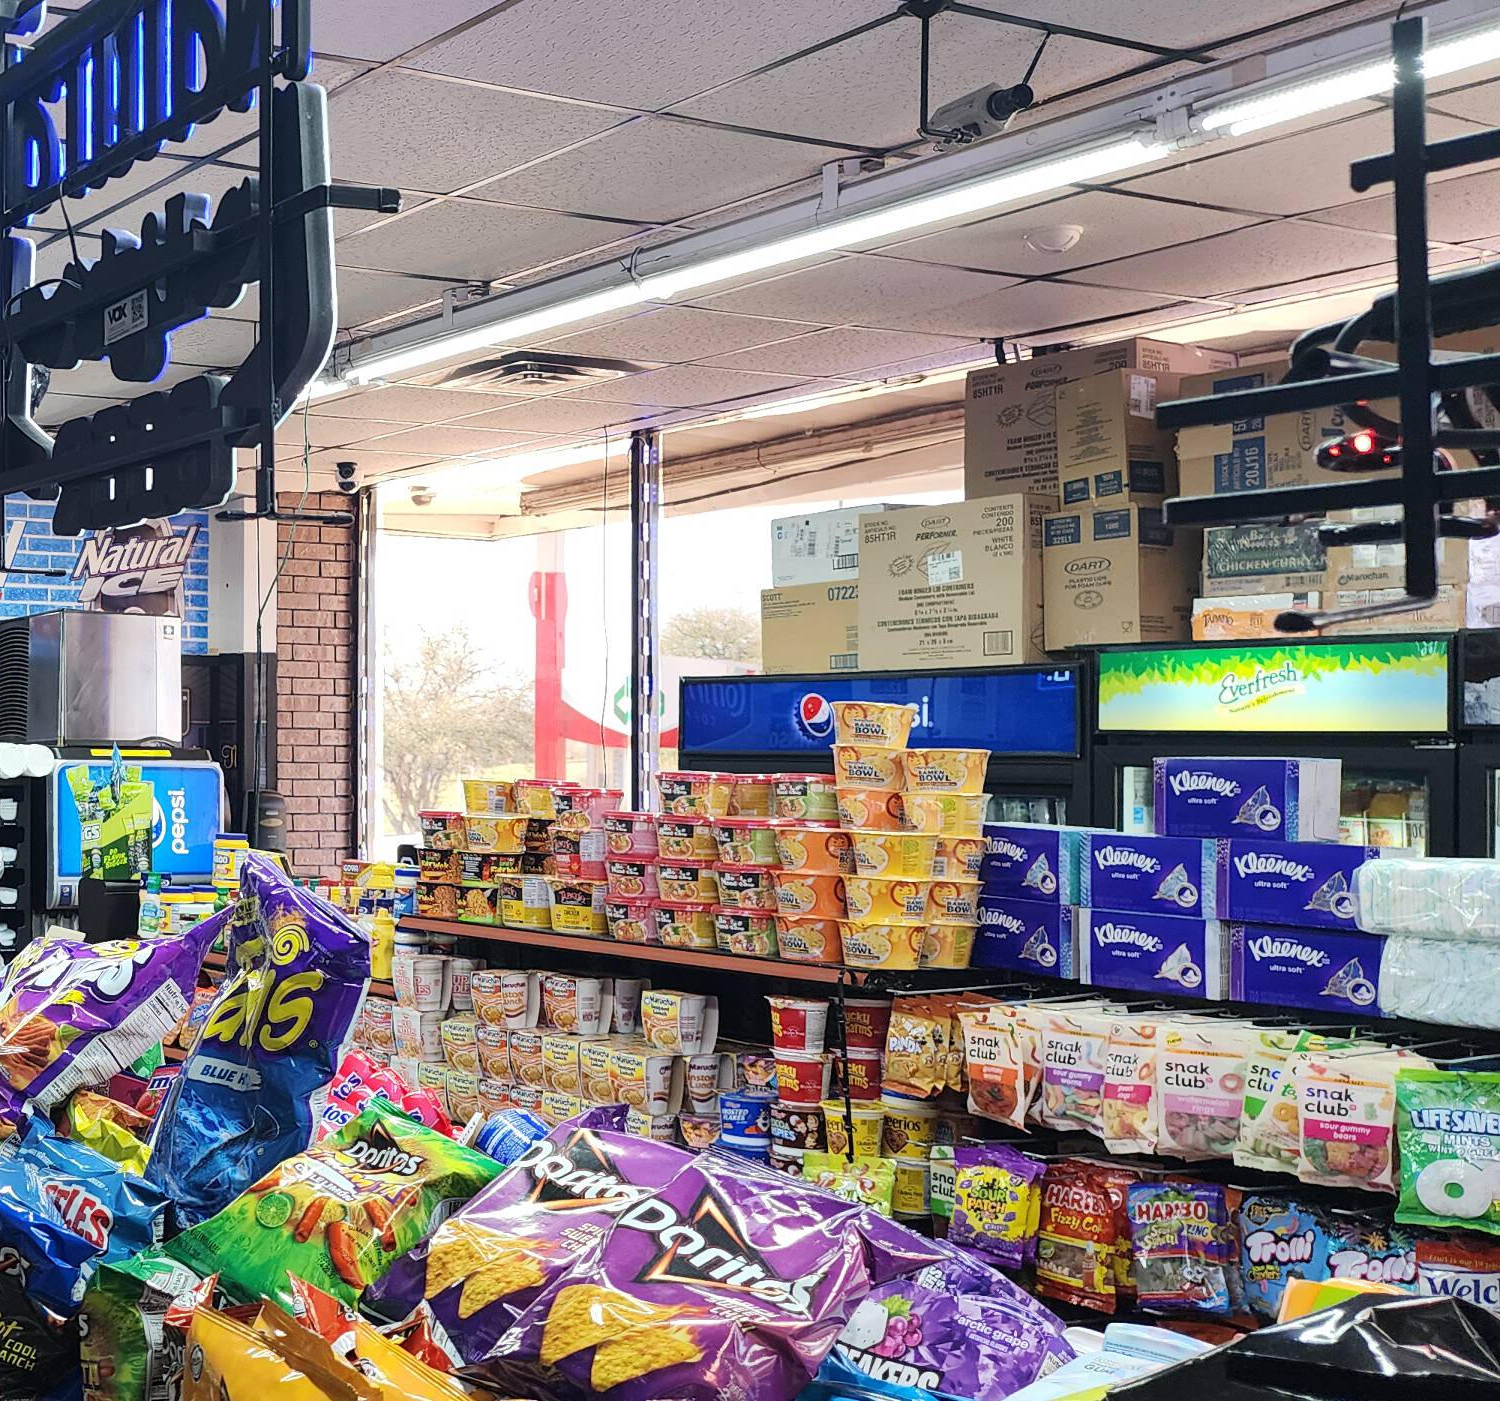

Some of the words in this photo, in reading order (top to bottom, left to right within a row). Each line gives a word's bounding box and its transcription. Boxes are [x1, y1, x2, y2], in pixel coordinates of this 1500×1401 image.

[107, 302, 127, 325] VOX
[973, 384, 1004, 400] 85HT1R
[1245, 447, 1260, 487] 20J16
[996, 517, 1014, 528] 200
[864, 531, 896, 544] 85HT1R
[72, 523, 200, 582] Natural
[1070, 560, 1105, 572] DART
[1219, 559, 1271, 573] CHICKEN
[78, 567, 184, 603] ICE
[1218, 662, 1297, 705] Everfresh
[855, 727, 886, 736] BOWL
[848, 769, 880, 778] BOWL
[919, 774, 951, 782] BOWL
[1168, 769, 1236, 796] Kleenex
[168, 787, 189, 855] pepsi
[1093, 844, 1157, 872] Kleenex
[1233, 850, 1311, 882] Kleenex
[1111, 872, 1125, 880] ultra
[1254, 880, 1272, 888] ultra
[1274, 881, 1289, 889] soft
[1093, 922, 1159, 953] Kleenex
[1111, 949, 1127, 957] ultra
[1248, 934, 1327, 968] Kleenex
[1269, 963, 1286, 972] ultra
[1288, 966, 1304, 974] soft
[649, 995, 677, 1006] Maruchan
[549, 1041, 575, 1051] Maruchan
[969, 1034, 1000, 1048] snak
[1047, 1039, 1082, 1053] snak
[616, 1056, 643, 1067] Maruchan
[969, 1047, 997, 1061] club
[1046, 1051, 1077, 1066] club
[1107, 1052, 1138, 1065] snak
[201, 1064, 238, 1081] BLUE
[1052, 1068, 1068, 1077] sour
[1069, 1071, 1092, 1082] gummy
[1164, 1060, 1210, 1076] snak
[1164, 1075, 1206, 1090] club
[1306, 1086, 1354, 1102] snak
[549, 1097, 575, 1108] Maruchan
[1304, 1102, 1349, 1117] club
[1320, 1122, 1339, 1133] sour
[1340, 1124, 1371, 1136] gummy
[1332, 1130, 1357, 1142] bears
[1444, 1133, 1492, 1148] MINTS
[344, 1140, 426, 1176] Doritos
[970, 1187, 1006, 1202] SOUR
[967, 1198, 1007, 1214] PATCH
[1135, 1200, 1208, 1222] HARIBO
[1051, 1208, 1079, 1230] Fizzy
[1187, 1224, 1210, 1238] ZING
[1244, 1229, 1315, 1263] Trolli
[614, 1197, 822, 1316] Doritos
[958, 1316, 988, 1334] arctic
[990, 1327, 1030, 1350] grape
[4, 1338, 37, 1360] COOL
